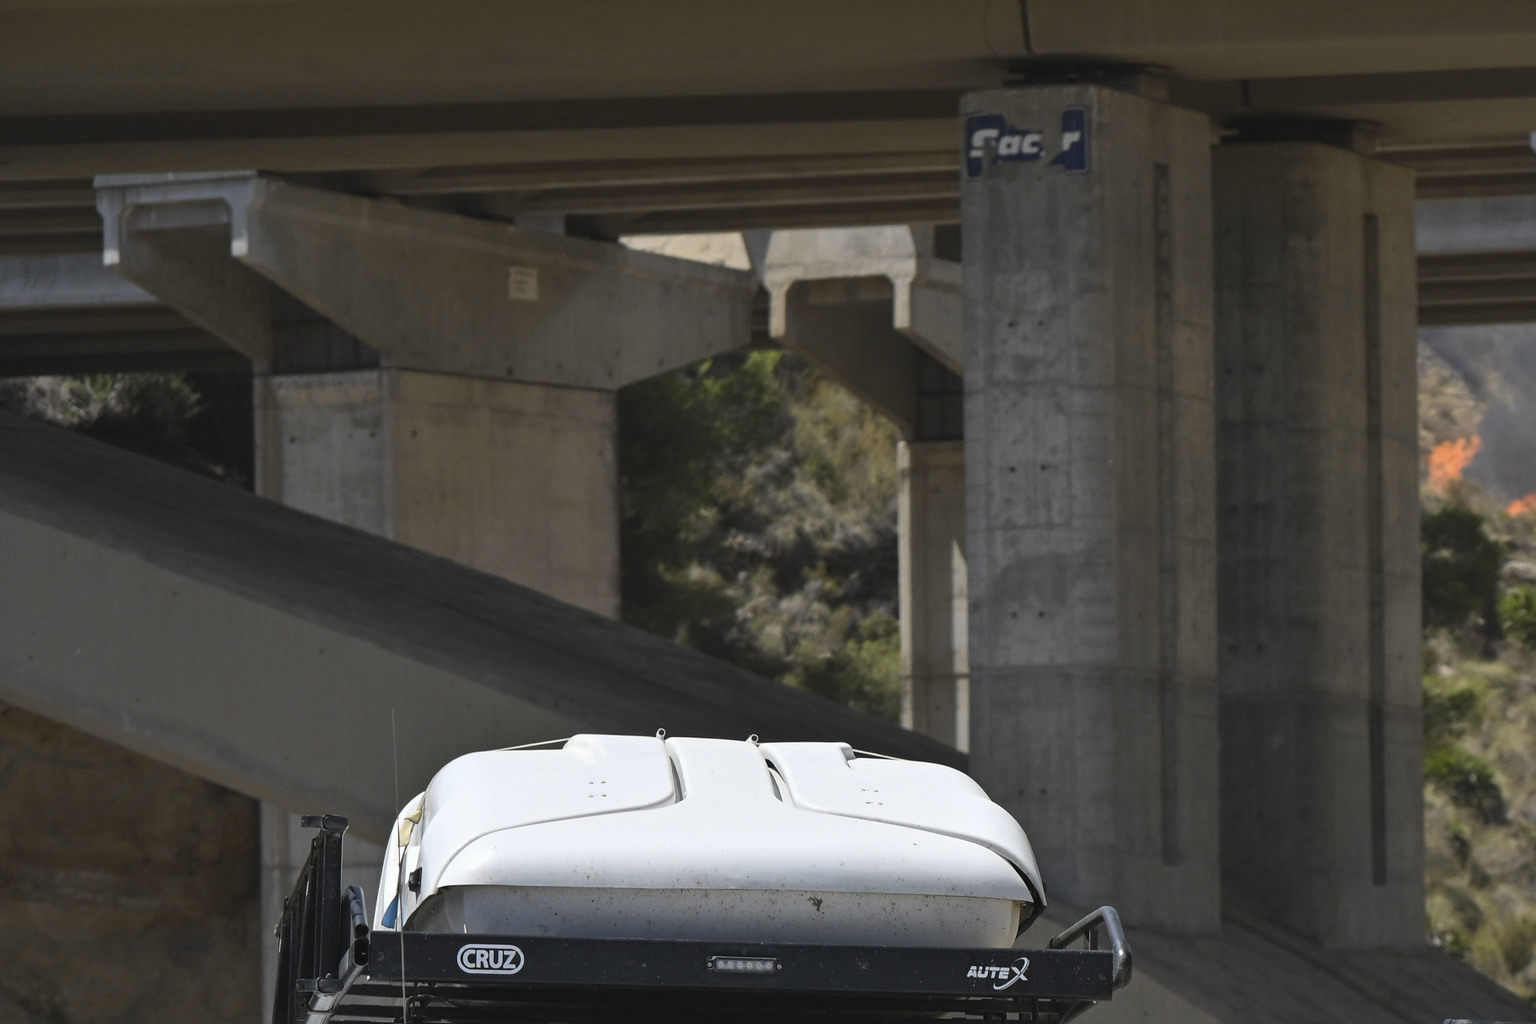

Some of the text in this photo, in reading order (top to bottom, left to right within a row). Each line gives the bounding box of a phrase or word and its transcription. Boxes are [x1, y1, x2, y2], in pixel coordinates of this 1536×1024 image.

[968, 128, 1082, 158] Sacr
[462, 949, 517, 969] CRUZ
[966, 957, 1029, 990] AUTEX
